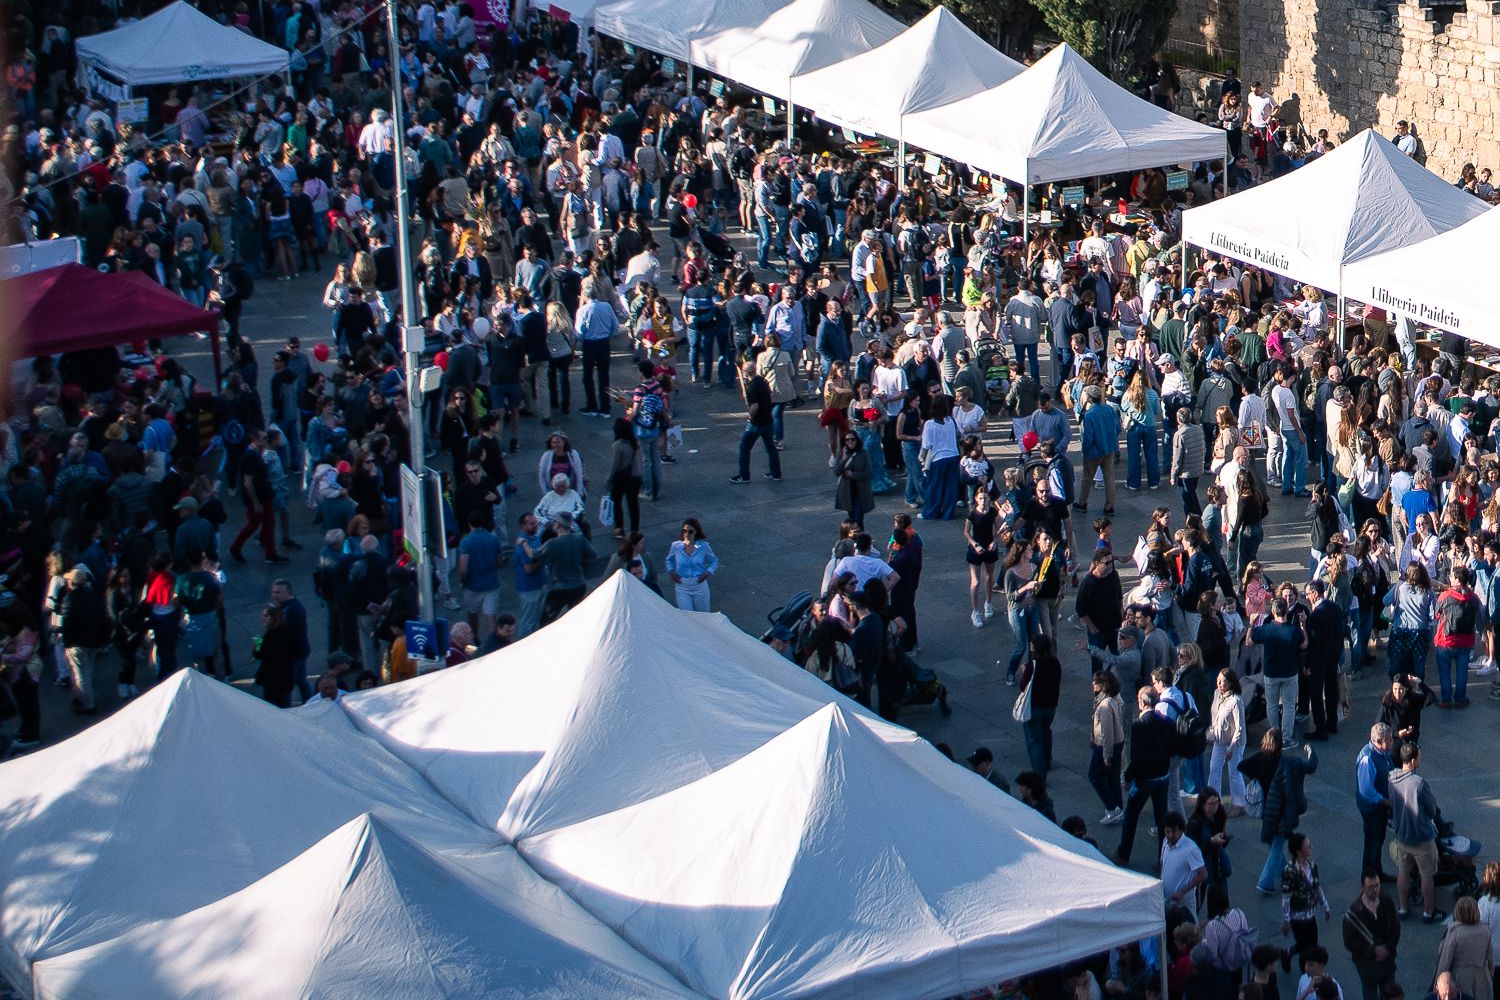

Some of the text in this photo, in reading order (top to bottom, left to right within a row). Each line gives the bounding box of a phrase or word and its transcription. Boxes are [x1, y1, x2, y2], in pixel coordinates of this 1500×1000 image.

[1210, 231, 1289, 271] Llibreria Paideia
[1371, 286, 1460, 328] Llibreria Paideia
